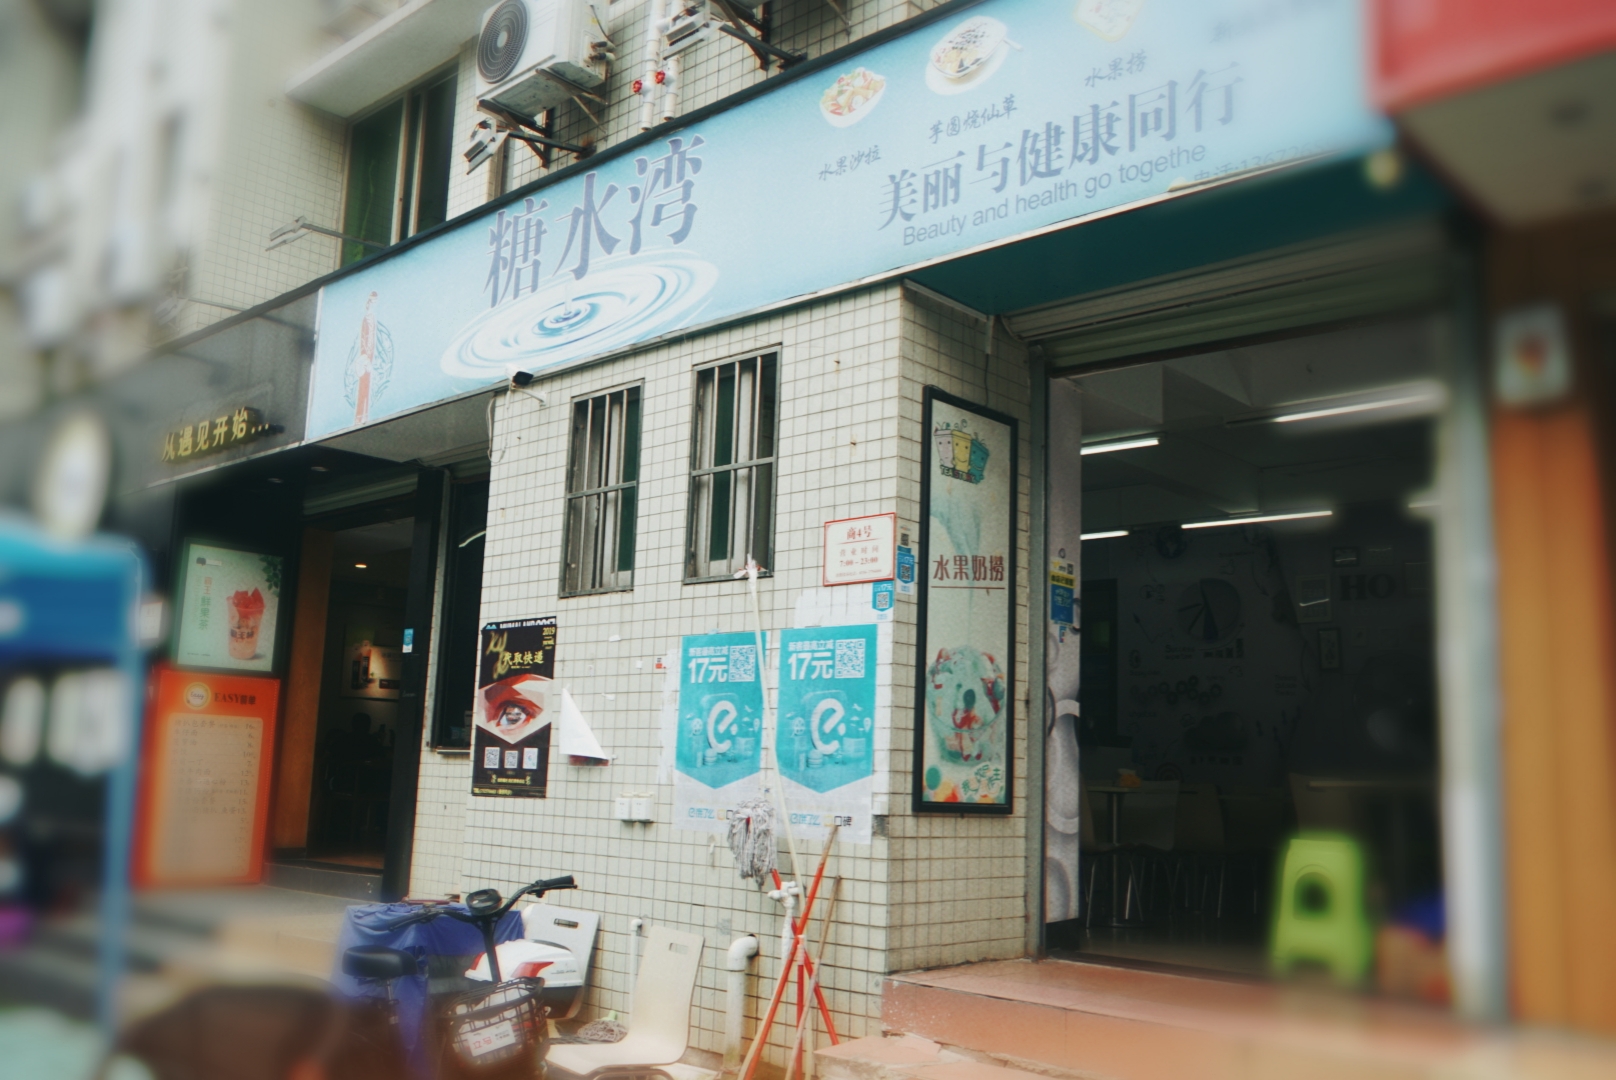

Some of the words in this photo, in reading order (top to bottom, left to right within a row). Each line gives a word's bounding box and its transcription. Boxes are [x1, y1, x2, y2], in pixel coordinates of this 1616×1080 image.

[1083, 50, 1147, 89] 水果捞
[928, 93, 1018, 145] 芋圆烧仙草
[817, 144, 882, 183] 水果沙拉
[876, 60, 1246, 231] 美丽与健康同行
[902, 213, 968, 247] Beauty
[972, 200, 1010, 228] and
[1014, 179, 1079, 217] health
[1083, 171, 1113, 198] go
[1117, 143, 1207, 186] togethe
[482, 134, 706, 308] 糖水湾
[932, 554, 1005, 582] 水果奶捞
[687, 656, 728, 684] 17元
[787, 651, 834, 681] 17元
